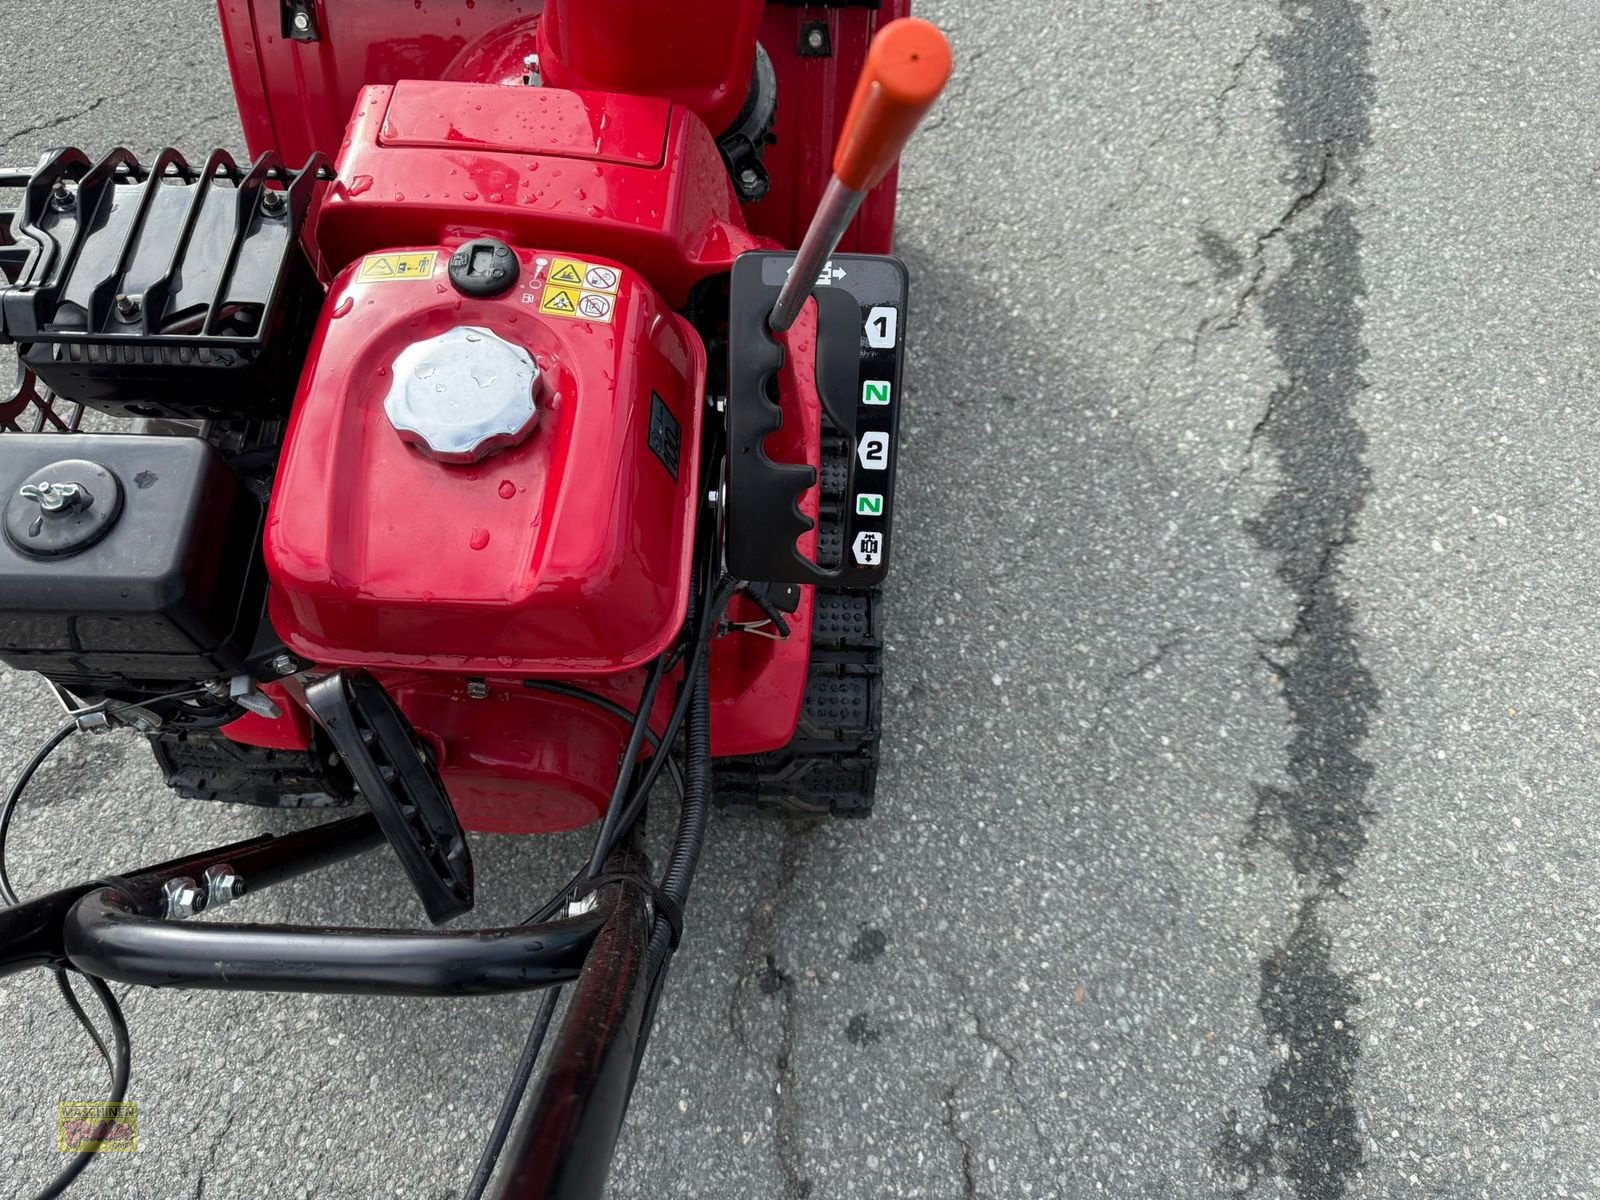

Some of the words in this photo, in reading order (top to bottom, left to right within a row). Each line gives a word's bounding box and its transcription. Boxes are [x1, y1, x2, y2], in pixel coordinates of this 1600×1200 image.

[873, 317, 887, 338] 1
[865, 384, 888, 402] N
[866, 440, 883, 461] 2
[858, 497, 881, 513] N
